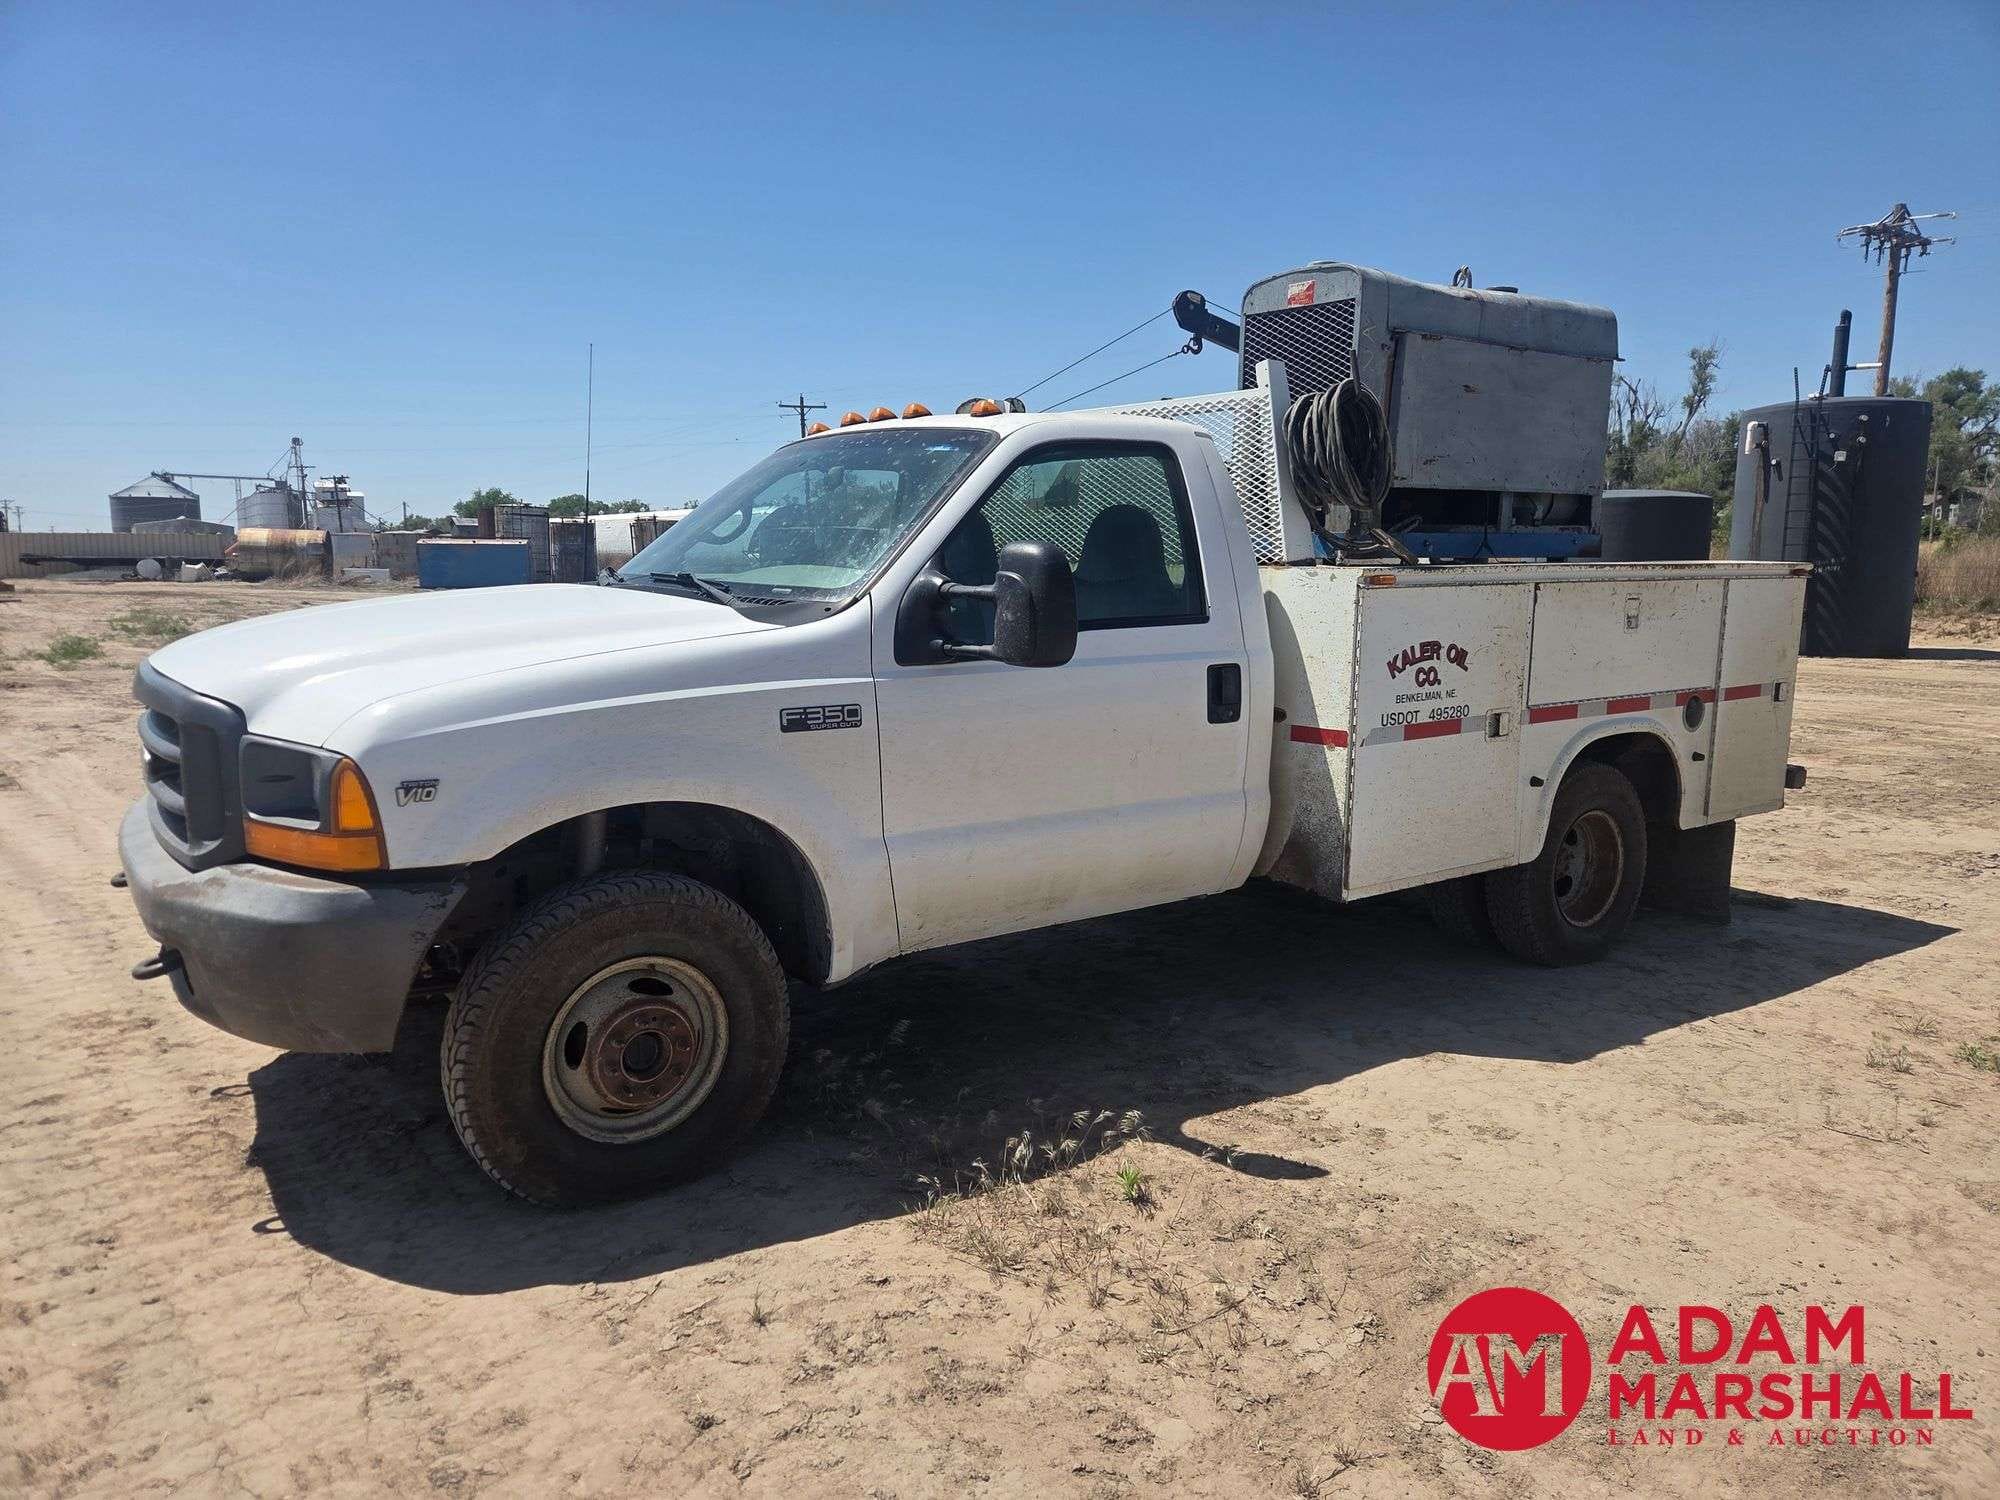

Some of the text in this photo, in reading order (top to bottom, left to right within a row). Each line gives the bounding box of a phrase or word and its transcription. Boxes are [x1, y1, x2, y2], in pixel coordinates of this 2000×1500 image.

[1387, 640, 1469, 679] KALER OIL
[1415, 666, 1442, 687] CO.
[1396, 691, 1443, 704] BENKELMAN,
[1381, 704, 1470, 727] USDOT 495280
[395, 786, 437, 807] V10
